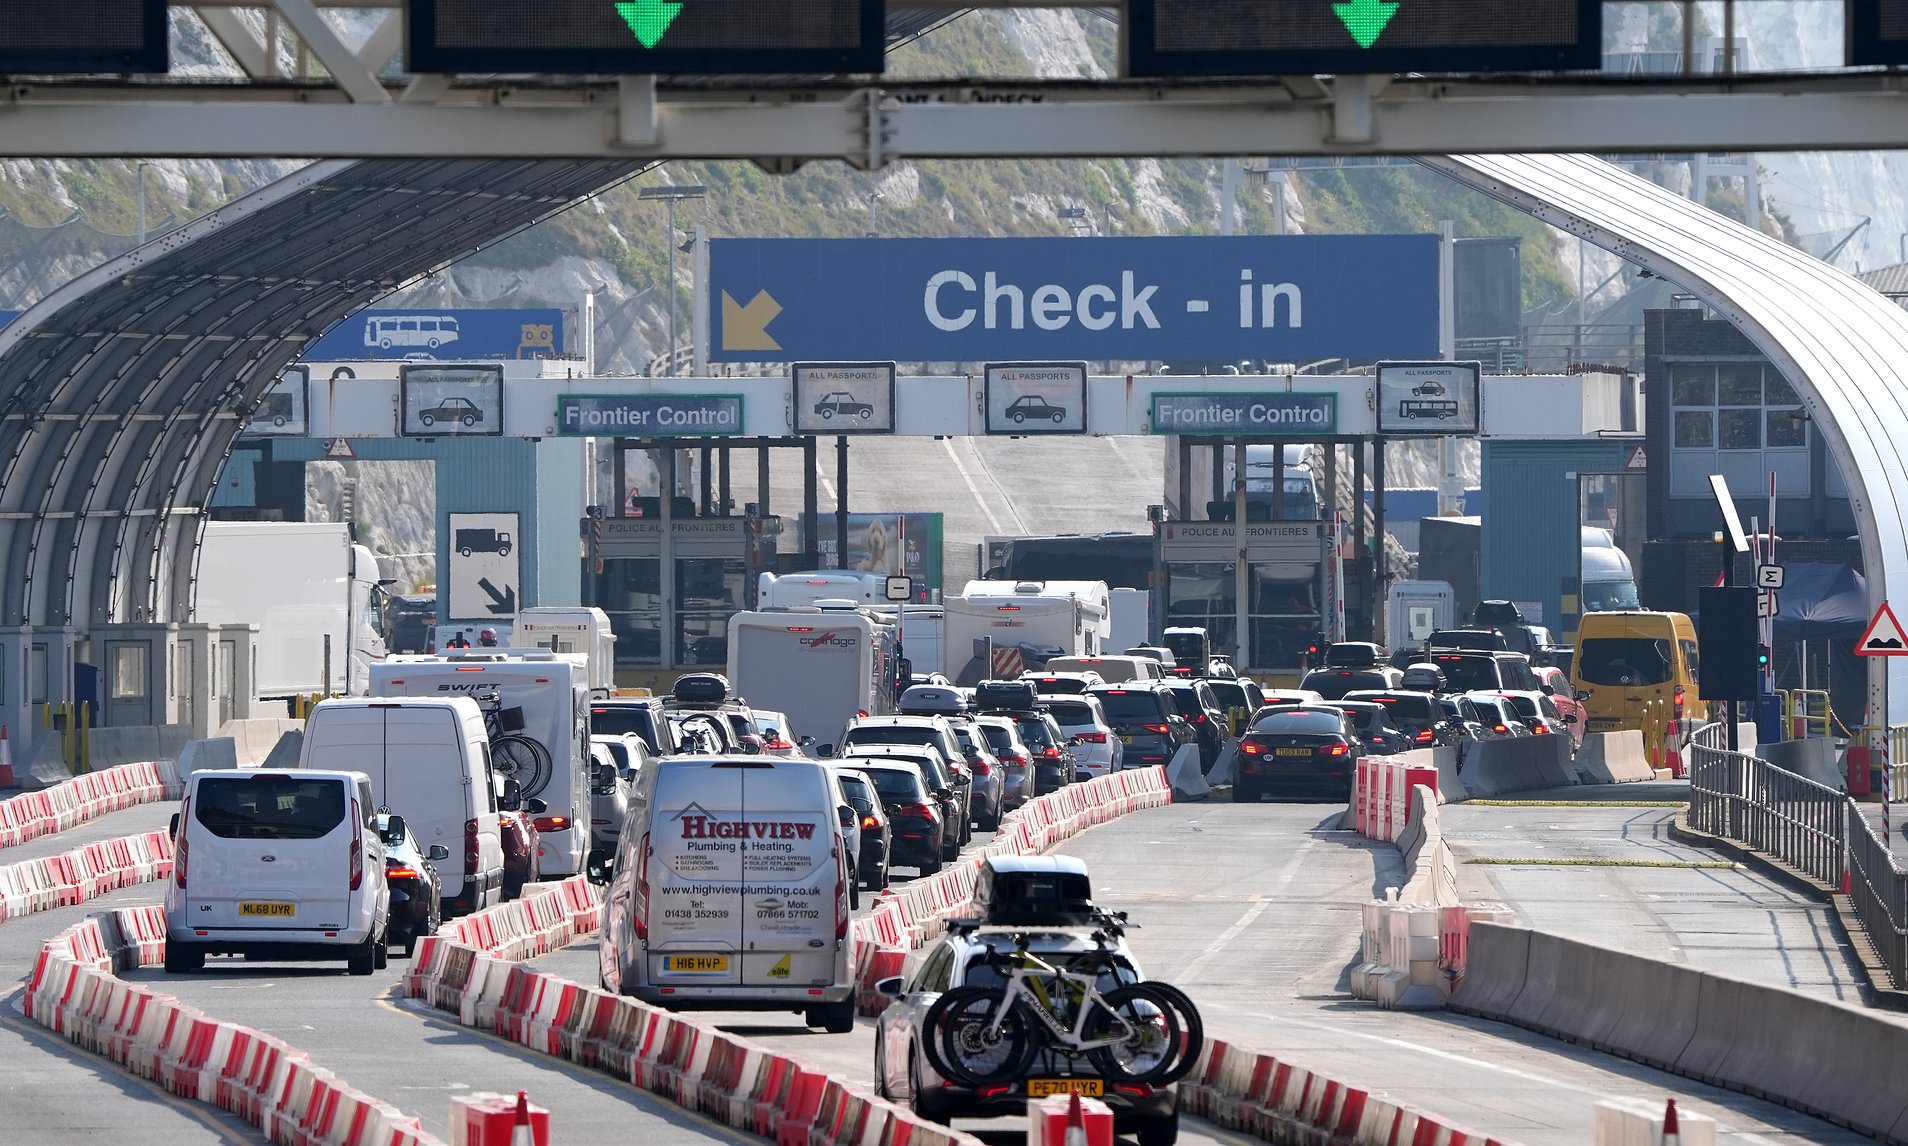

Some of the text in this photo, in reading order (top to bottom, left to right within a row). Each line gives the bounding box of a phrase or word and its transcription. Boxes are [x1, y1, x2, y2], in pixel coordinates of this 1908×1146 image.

[924, 269, 1301, 332] Check - in
[809, 372, 878, 380] ALL PASSPORTS
[1001, 372, 1071, 380] ALL PASSPORTS
[566, 406, 735, 426] Frontier Control
[1159, 404, 1329, 424] Frontier Control
[608, 523, 645, 533] POLICE
[671, 523, 736, 532] FRONTIERES
[1182, 527, 1309, 537] POLICE AU FRONTIERES
[800, 633, 856, 648] cahago
[437, 683, 501, 692] SWIFT
[681, 815, 816, 840] HIGHVIEW
[687, 841, 795, 853] Plumbing & Heating.
[662, 884, 821, 897] www.highviewplumbing.co.uk
[243, 903, 290, 915] ML68 UYR
[690, 900, 705, 909] Tel:
[787, 901, 808, 909] Mob:
[665, 909, 729, 919] 01438 352939
[788, 909, 819, 919] 571702
[697, 957, 720, 969] HVP
[1033, 1081, 1068, 1096] PE70
